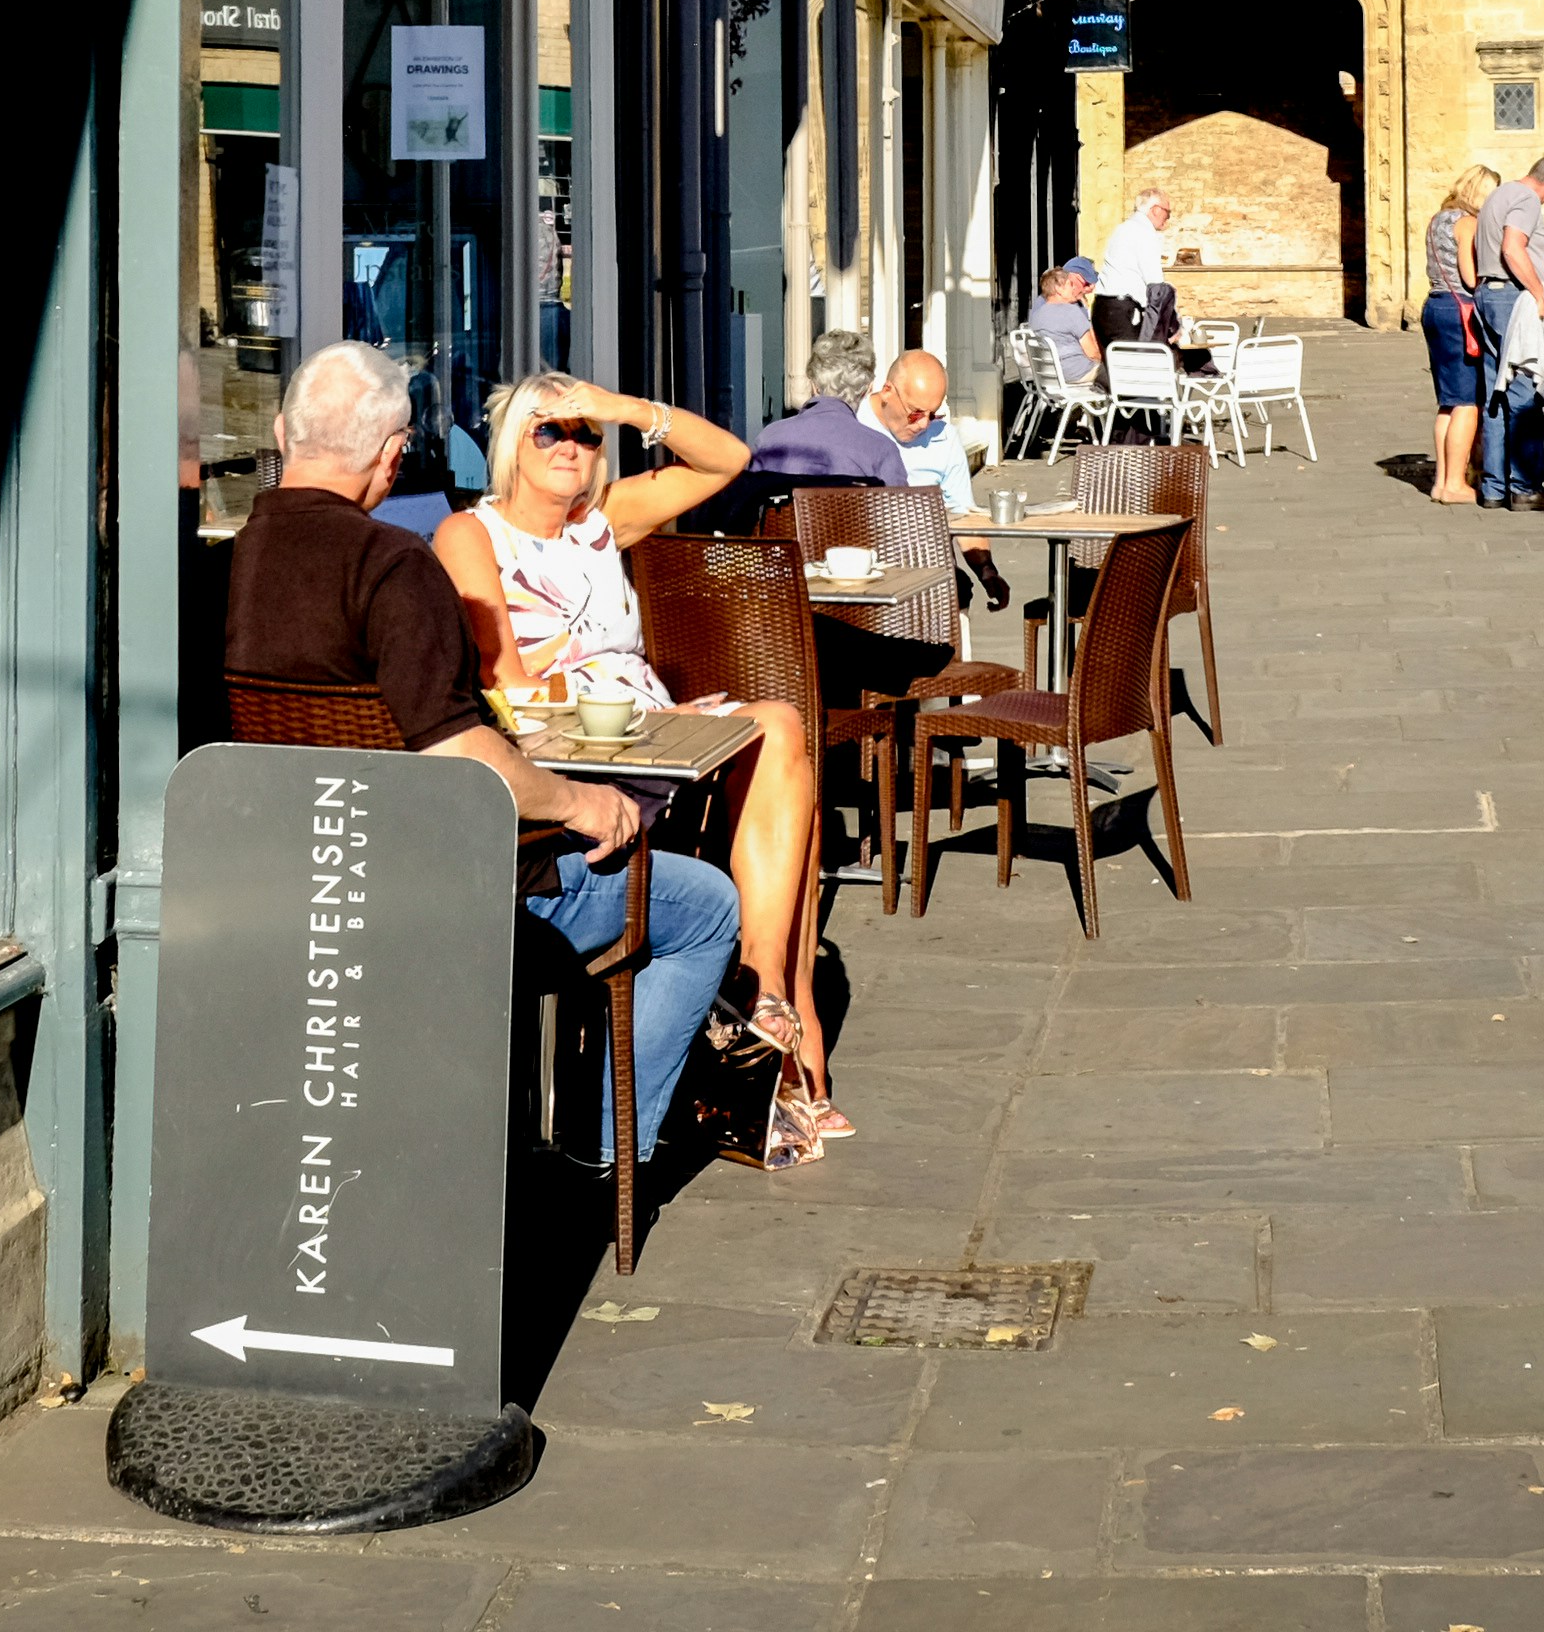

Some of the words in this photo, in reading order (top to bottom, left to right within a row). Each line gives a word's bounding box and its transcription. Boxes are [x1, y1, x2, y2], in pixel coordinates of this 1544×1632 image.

[406, 64, 469, 75] DRAWINGS
[1068, 39, 1119, 57] Boutique
[345, 780, 371, 931] BEAUTY
[303, 776, 348, 1107] CHRISTENSEN
[345, 963, 363, 980] &
[341, 1013, 361, 1108] HAIR
[295, 1135, 332, 1295] KAREN
